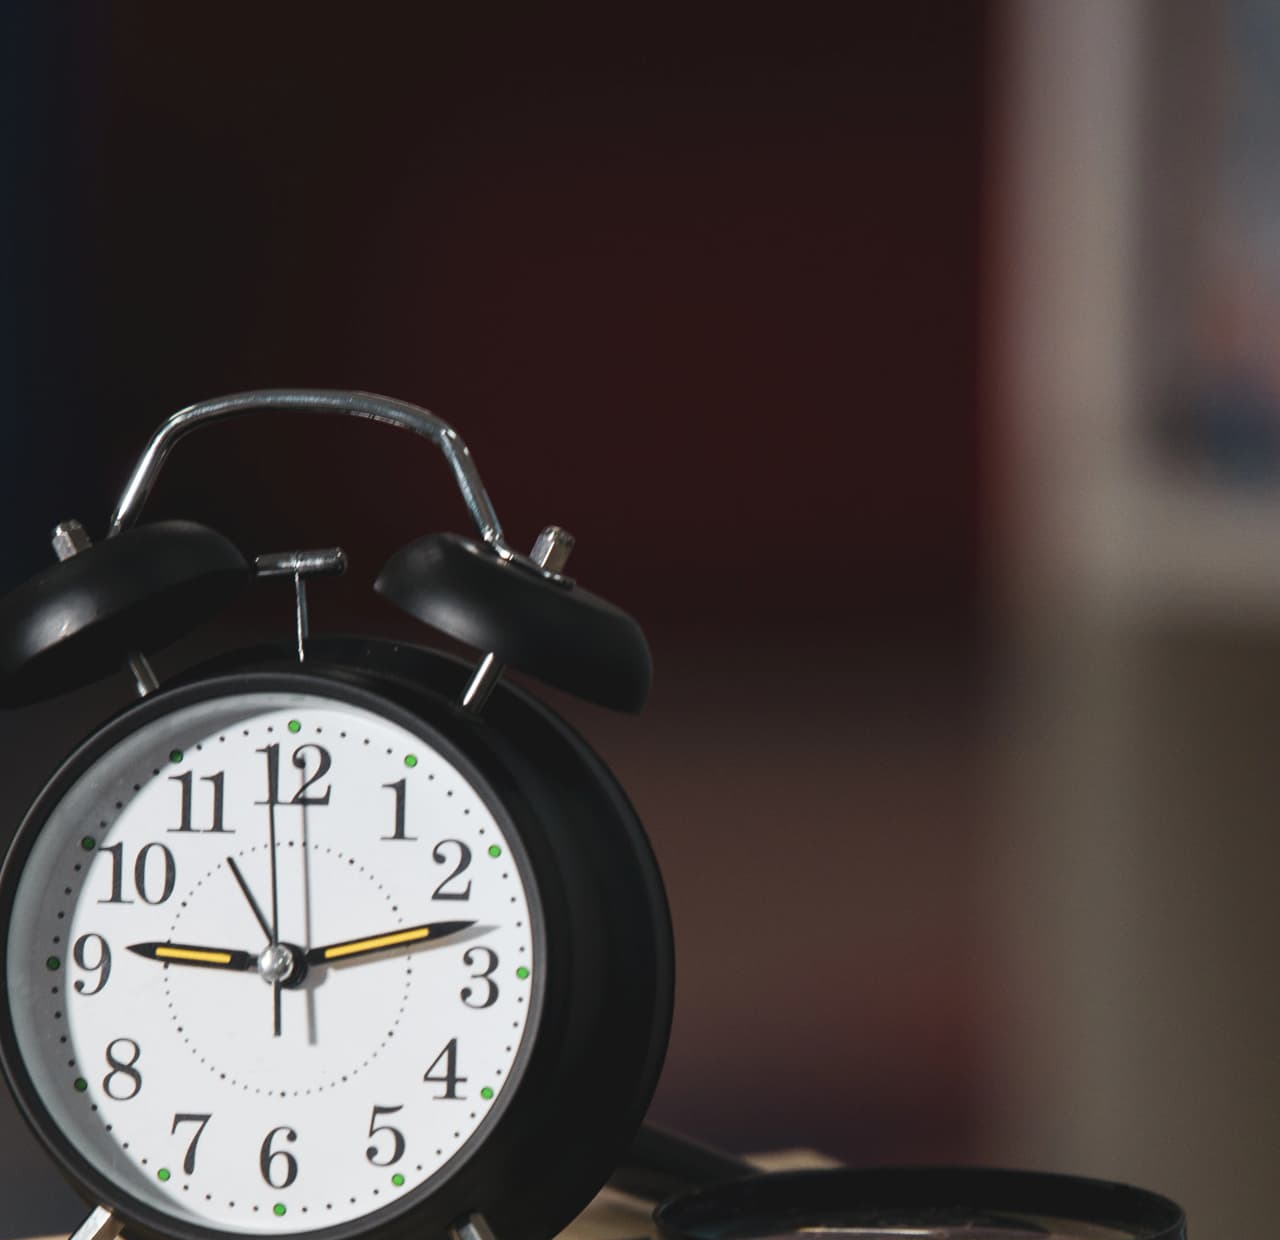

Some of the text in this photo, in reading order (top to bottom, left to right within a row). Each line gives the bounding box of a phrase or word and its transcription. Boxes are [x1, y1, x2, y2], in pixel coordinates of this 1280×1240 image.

[167, 770, 236, 833] 11
[254, 743, 332, 806] 12
[381, 778, 417, 841] 1
[97, 841, 177, 905] 10
[431, 839, 473, 902] 2
[72, 933, 112, 996] 9
[460, 946, 500, 1009] 3
[102, 1038, 143, 1101] 8
[423, 1038, 468, 1100] 4
[170, 1113, 212, 1176] 7
[259, 1126, 299, 1190] 6
[365, 1105, 406, 1167] 5
